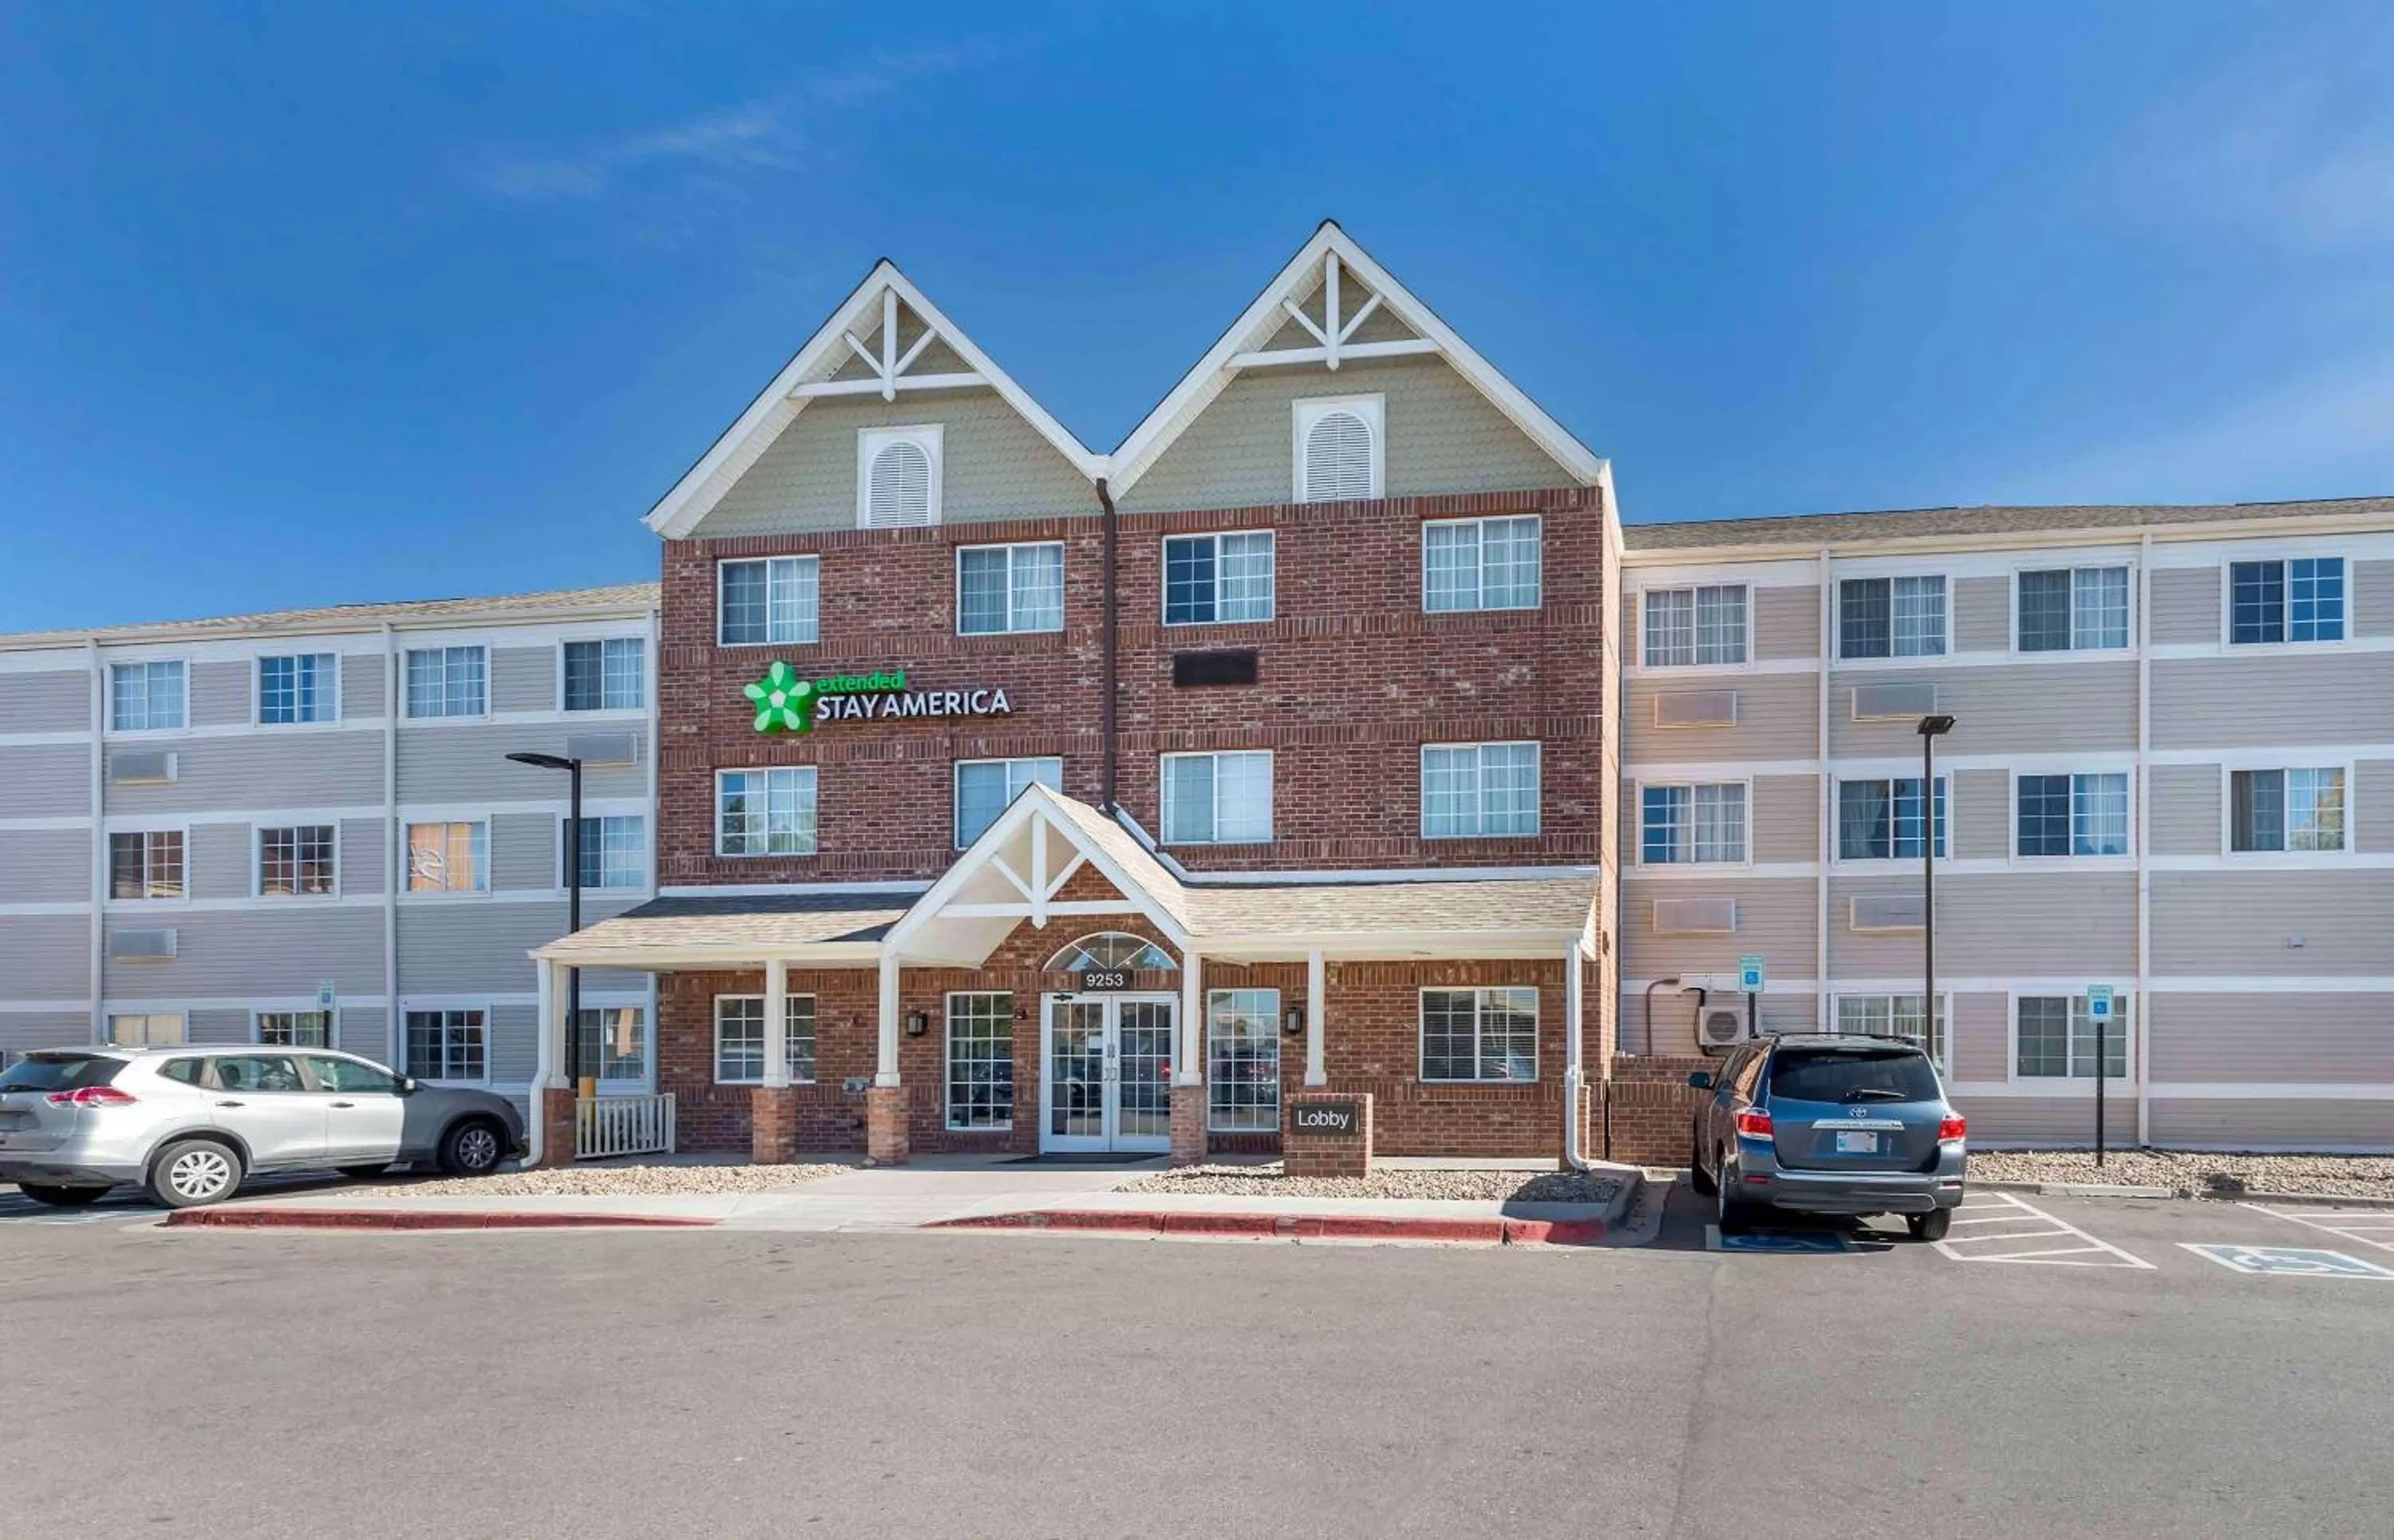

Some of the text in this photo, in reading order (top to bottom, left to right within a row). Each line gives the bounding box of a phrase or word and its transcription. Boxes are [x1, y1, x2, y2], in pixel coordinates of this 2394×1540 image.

[816, 670, 905, 692] extended
[816, 689, 1011, 719] STAY AMERICA
[1086, 973, 1124, 986] 9253
[1298, 1110, 1349, 1129] Lobby
